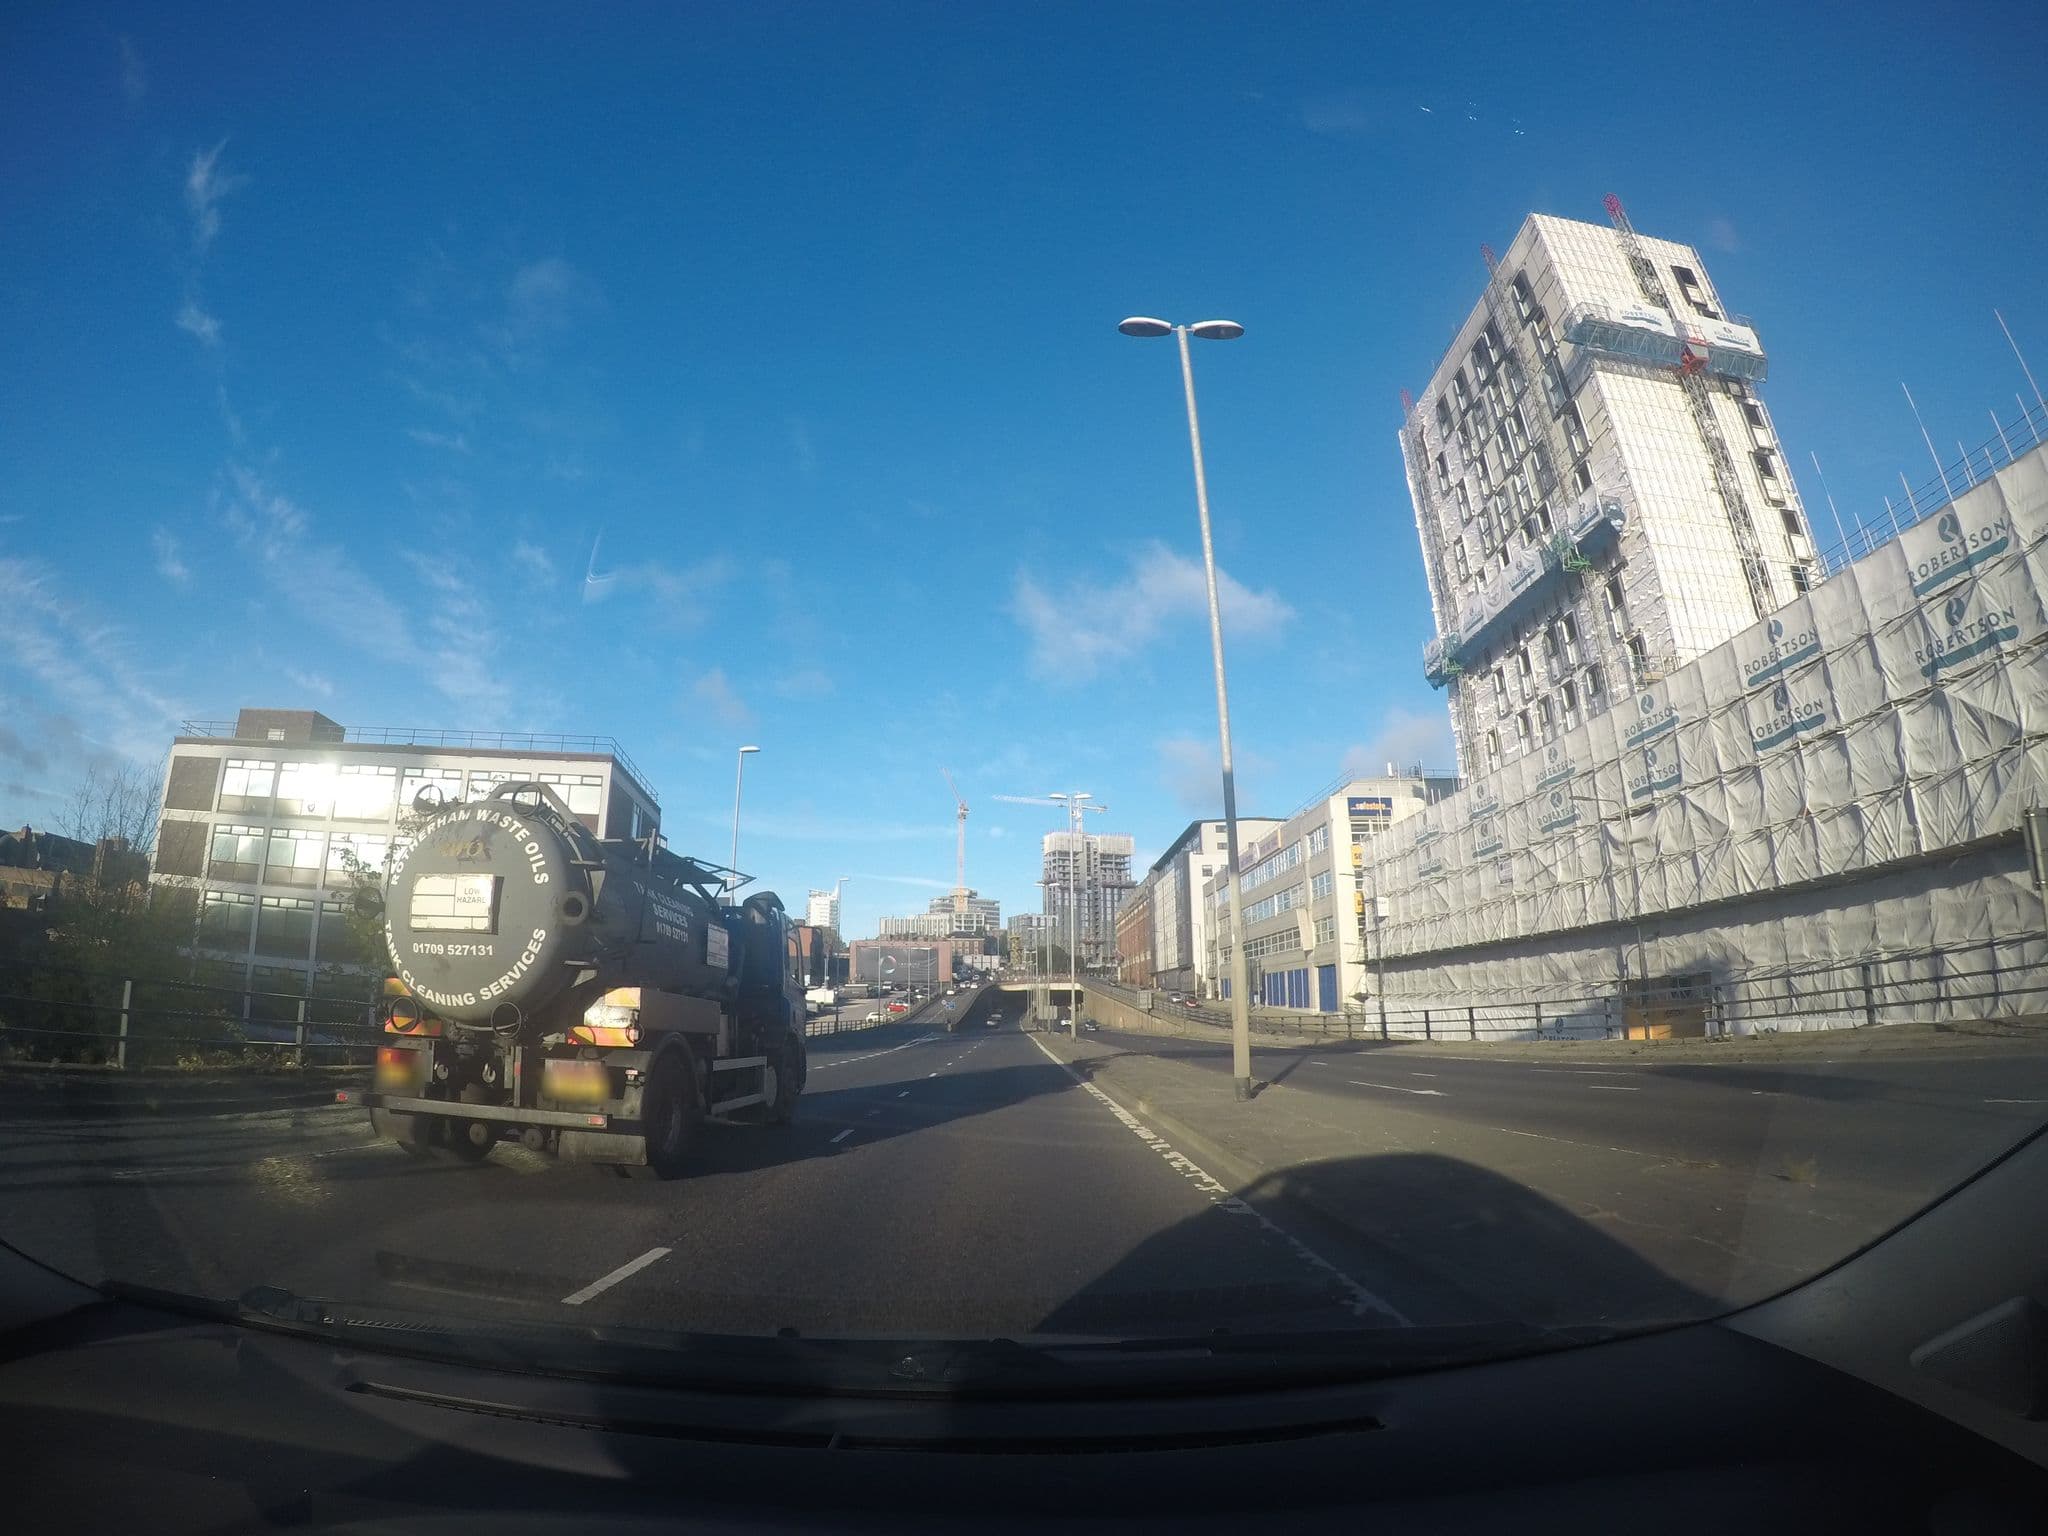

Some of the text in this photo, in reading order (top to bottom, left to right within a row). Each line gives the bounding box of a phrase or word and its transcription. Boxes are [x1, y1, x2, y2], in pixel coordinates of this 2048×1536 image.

[1744, 626, 1818, 676] ROBERTSON
[1914, 606, 2017, 665] ROBERTSON
[1623, 702, 1678, 738] ROBERTSON
[1755, 698, 1825, 738] OBERTSON
[475, 808, 531, 843] WASTE
[524, 841, 549, 886] OILS
[385, 919, 546, 1007] TANK CLEANING SERVICES
[412, 942, 493, 956] 01709 527131
